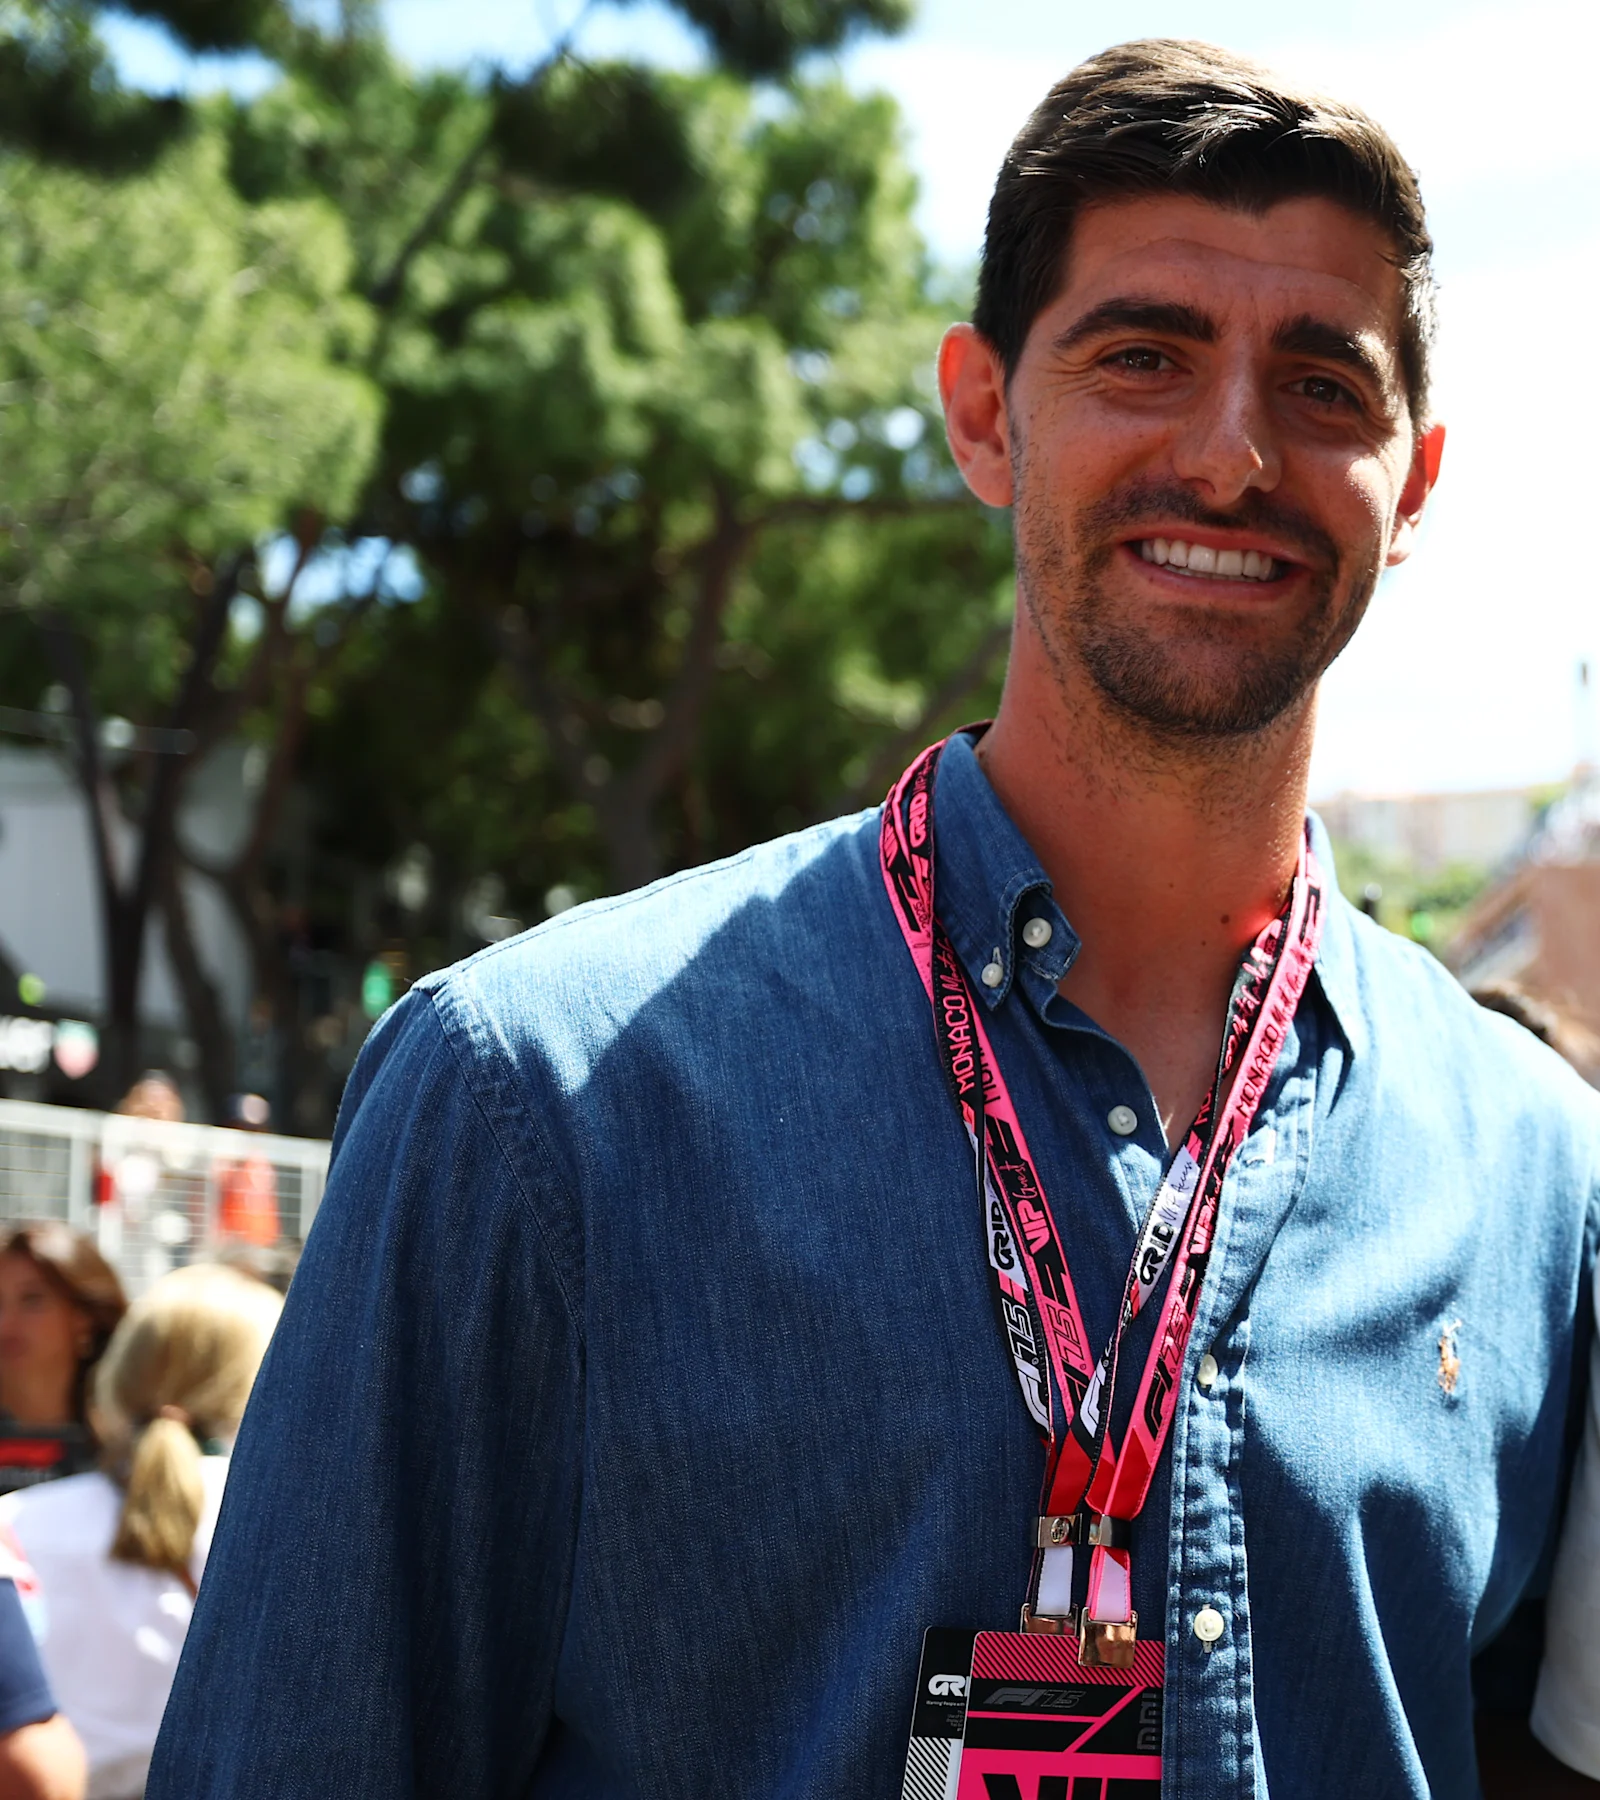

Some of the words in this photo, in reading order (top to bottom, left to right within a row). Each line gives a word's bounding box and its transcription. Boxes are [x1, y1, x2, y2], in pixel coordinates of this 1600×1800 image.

[909, 791, 929, 848] GRID
[942, 994, 976, 1095] MONACO
[1236, 1024, 1280, 1117] MONACO
[999, 1161, 1038, 1199] Guest
[1017, 1200, 1050, 1255] VIP
[1138, 1222, 1174, 1286] GRID
[1190, 1205, 1213, 1254] VIP
[1002, 1298, 1037, 1358] 75
[1046, 1304, 1085, 1362] 75
[1159, 1302, 1191, 1365] 75
[928, 1674, 970, 1697] GRI
